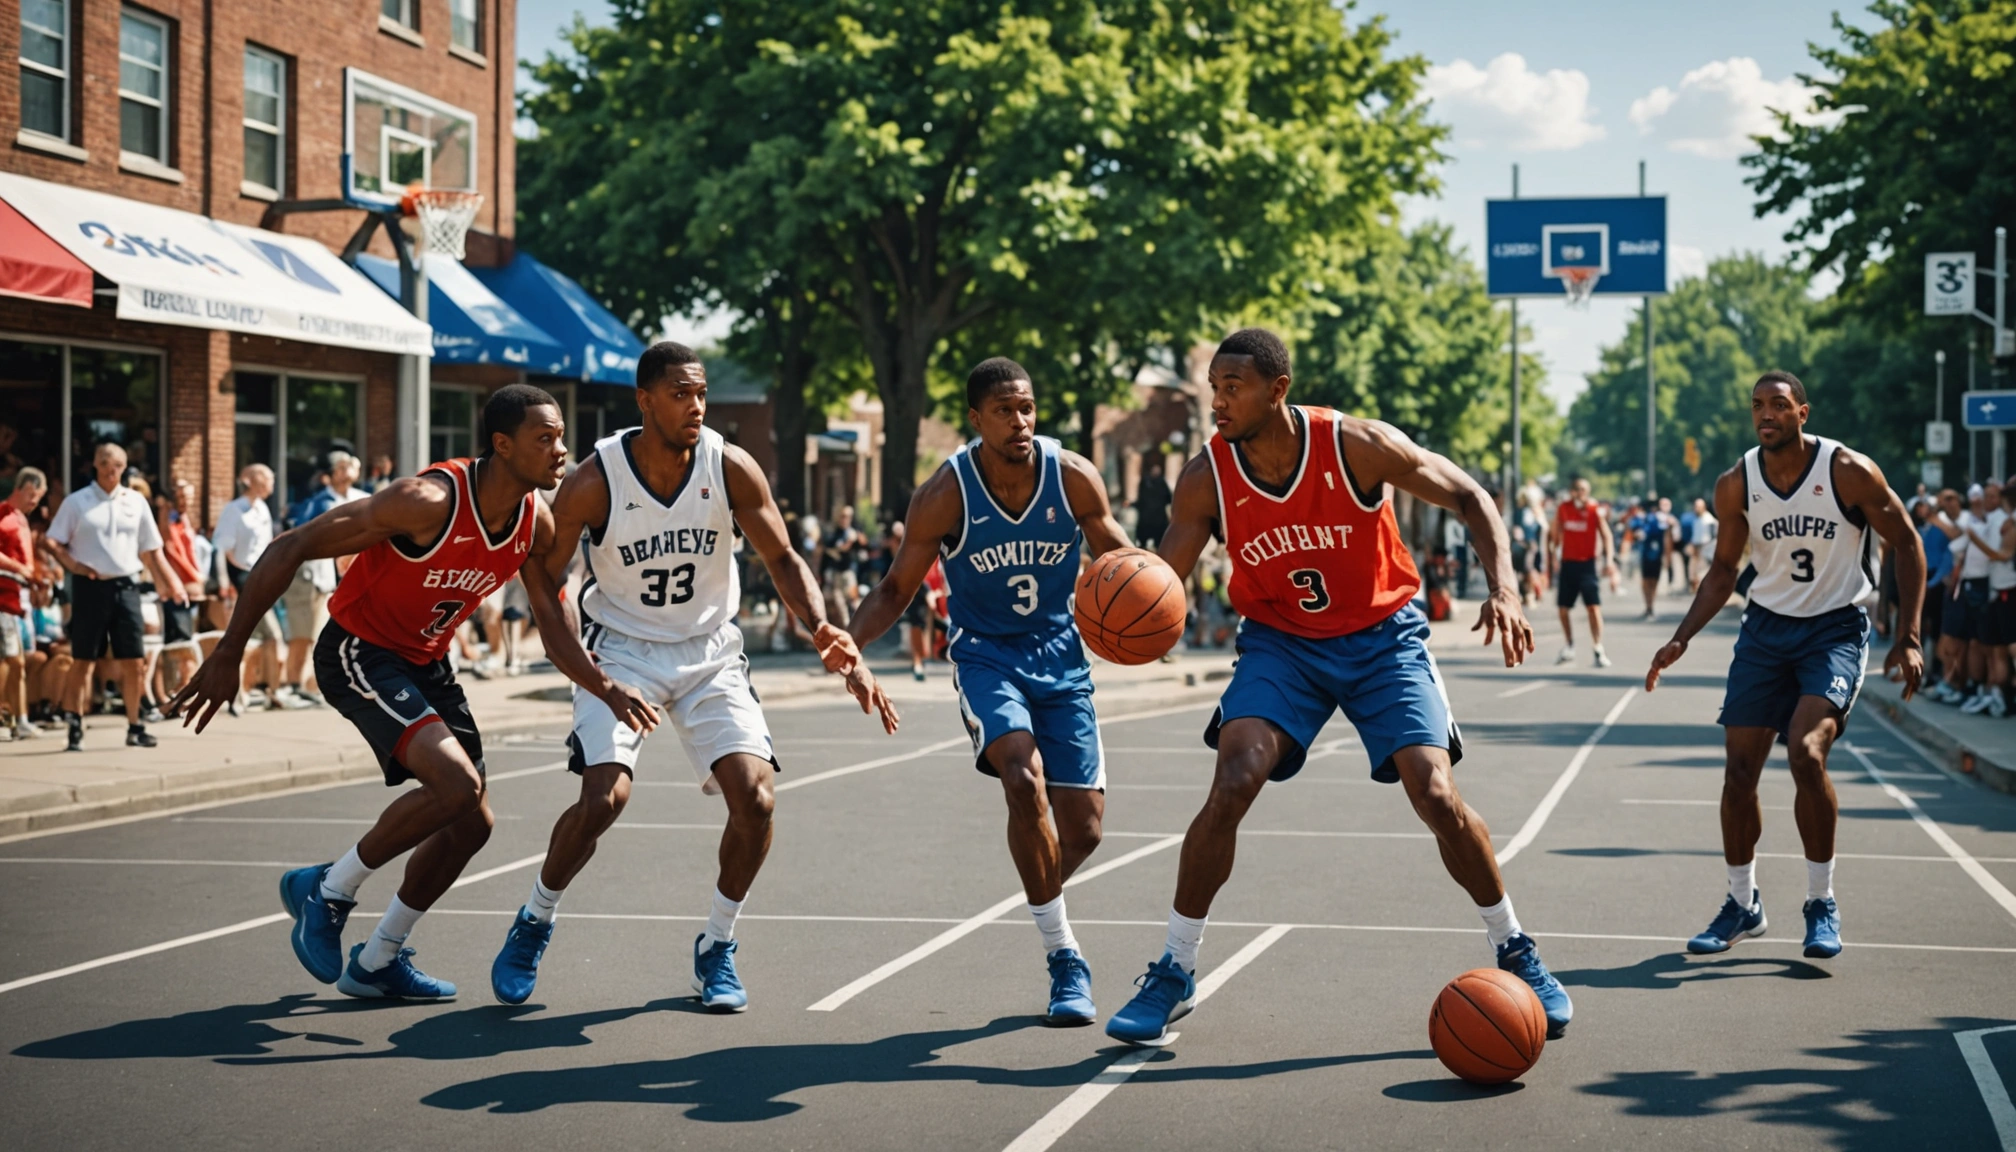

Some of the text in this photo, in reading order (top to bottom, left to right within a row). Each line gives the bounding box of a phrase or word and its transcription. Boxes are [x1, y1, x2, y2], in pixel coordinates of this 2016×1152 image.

[640, 562, 696, 607] 33
[1791, 548, 1814, 583] 3
[1007, 574, 1039, 616] 3
[1288, 568, 1331, 613] 3
